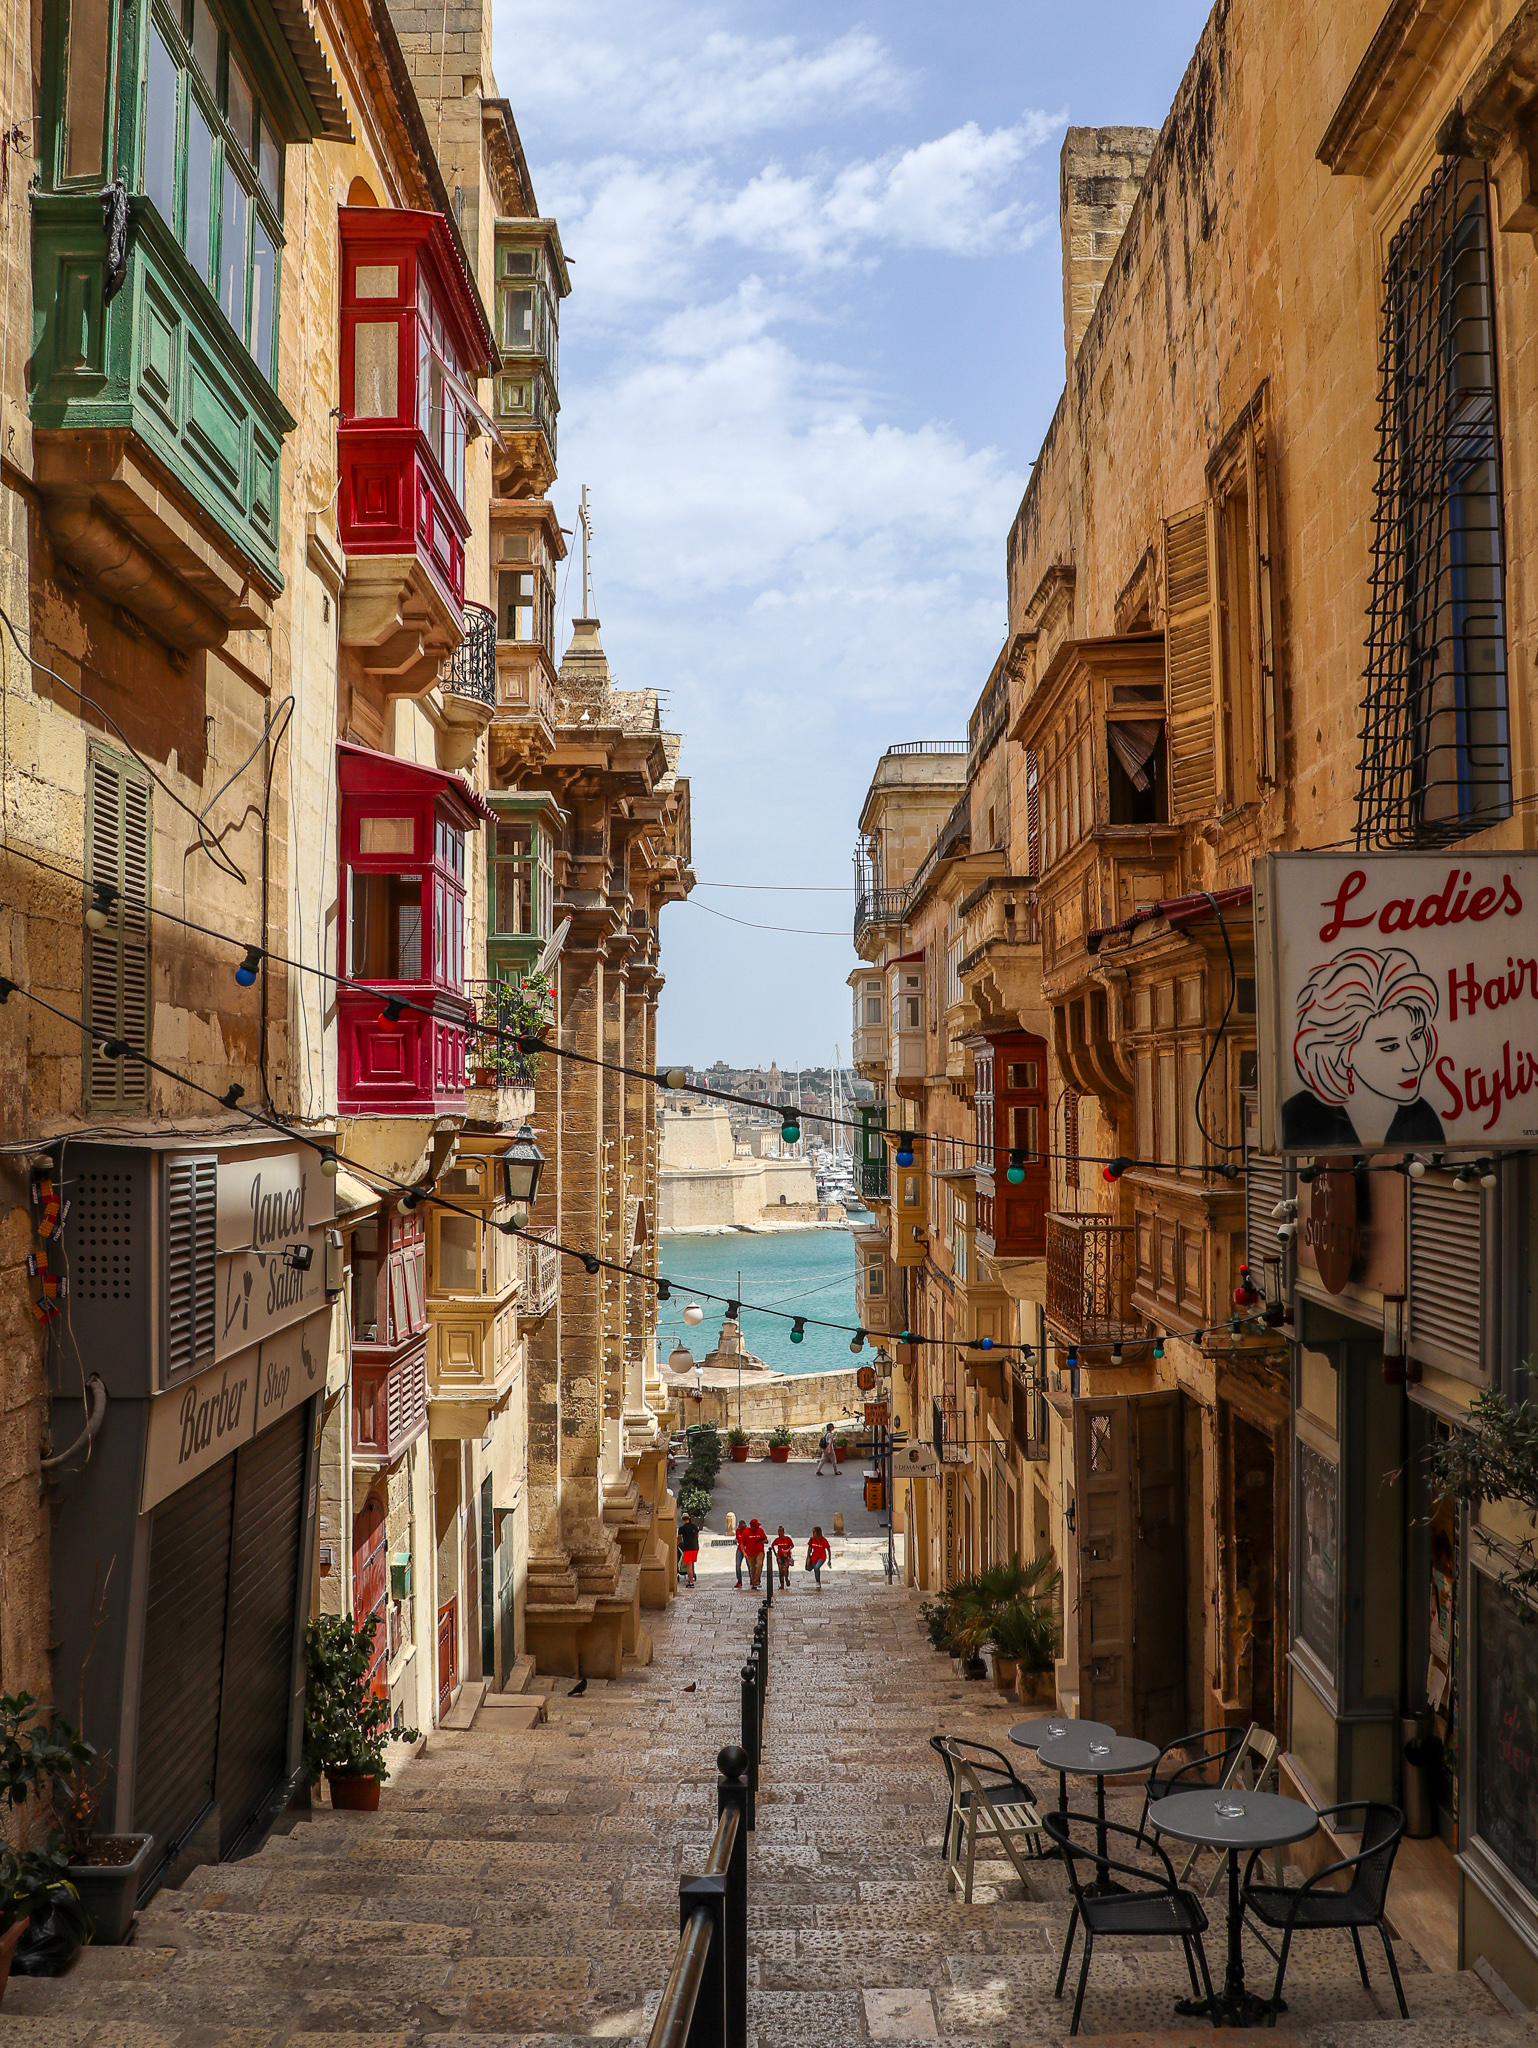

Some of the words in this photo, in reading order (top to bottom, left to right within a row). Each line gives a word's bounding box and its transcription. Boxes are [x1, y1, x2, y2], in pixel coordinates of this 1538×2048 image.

[1319, 869, 1523, 942] Ladies
[1448, 956, 1538, 1022] Hair
[267, 1257, 304, 1316] Salon
[178, 1370, 248, 1464] Barber
[263, 1362, 290, 1409] Shop
[947, 1477, 953, 1486] S
